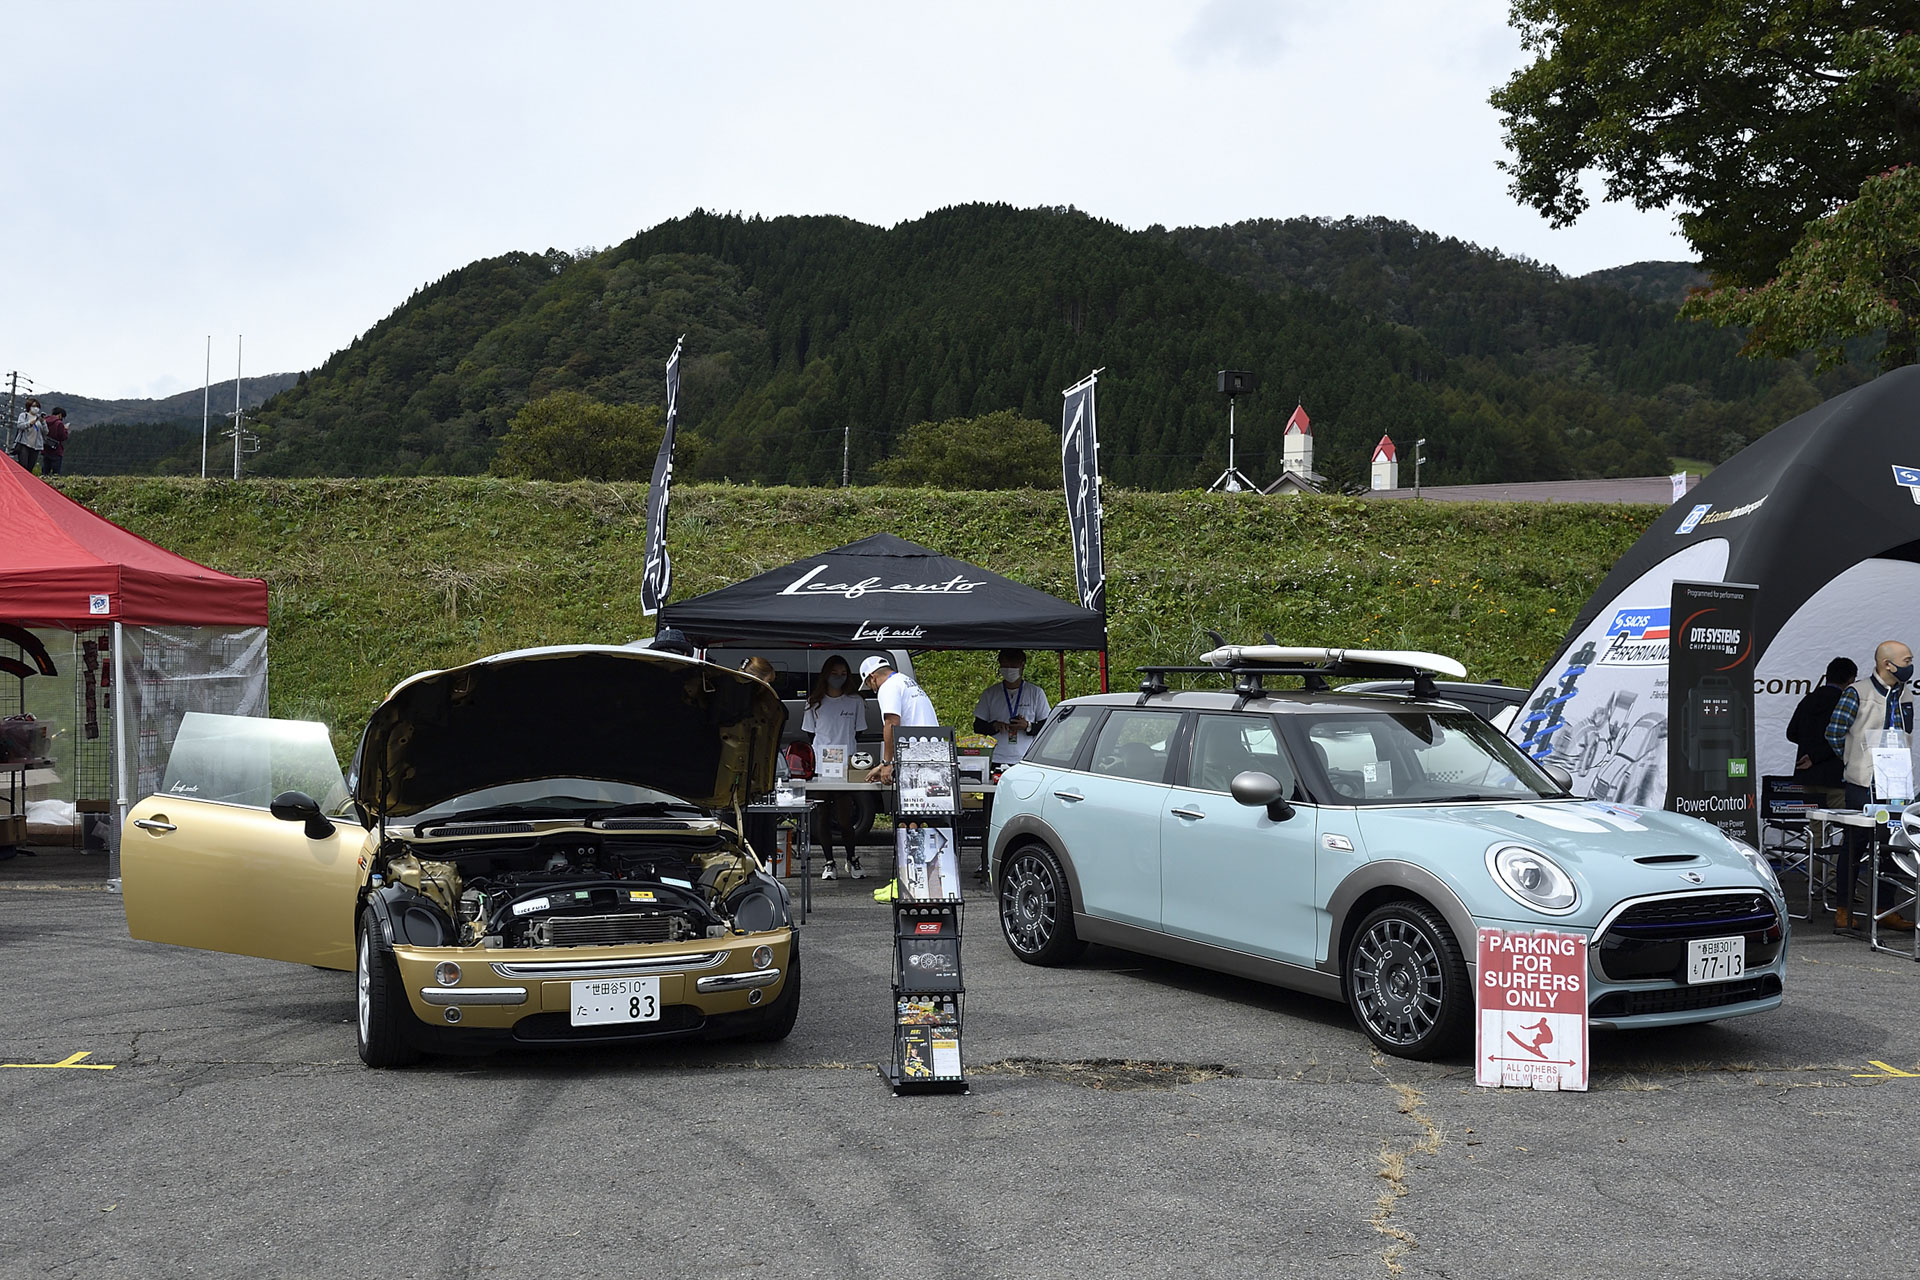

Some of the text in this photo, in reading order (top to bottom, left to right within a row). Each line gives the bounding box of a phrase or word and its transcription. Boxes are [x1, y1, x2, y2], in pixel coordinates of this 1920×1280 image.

[776, 564, 987, 598] Leaf auto
[1623, 615, 1651, 627] SACHS
[851, 620, 927, 642] Leaf auto
[1691, 627, 1740, 644] DTE SYSTEMS
[1731, 761, 1745, 774] New
[1676, 794, 1747, 812] PowerControl
[1489, 936, 1576, 956] PARKING
[1512, 955, 1552, 972] FOR
[1701, 954, 1742, 979] 77-13
[1484, 971, 1580, 992] SURFERS
[1505, 989, 1559, 1008] ONLY
[576, 1005, 588, 1016] た
[1506, 1063, 1558, 1074] ALL OTHERS
[1502, 1072, 1520, 1081] WILL
[1546, 1075, 1563, 1084] OUT
